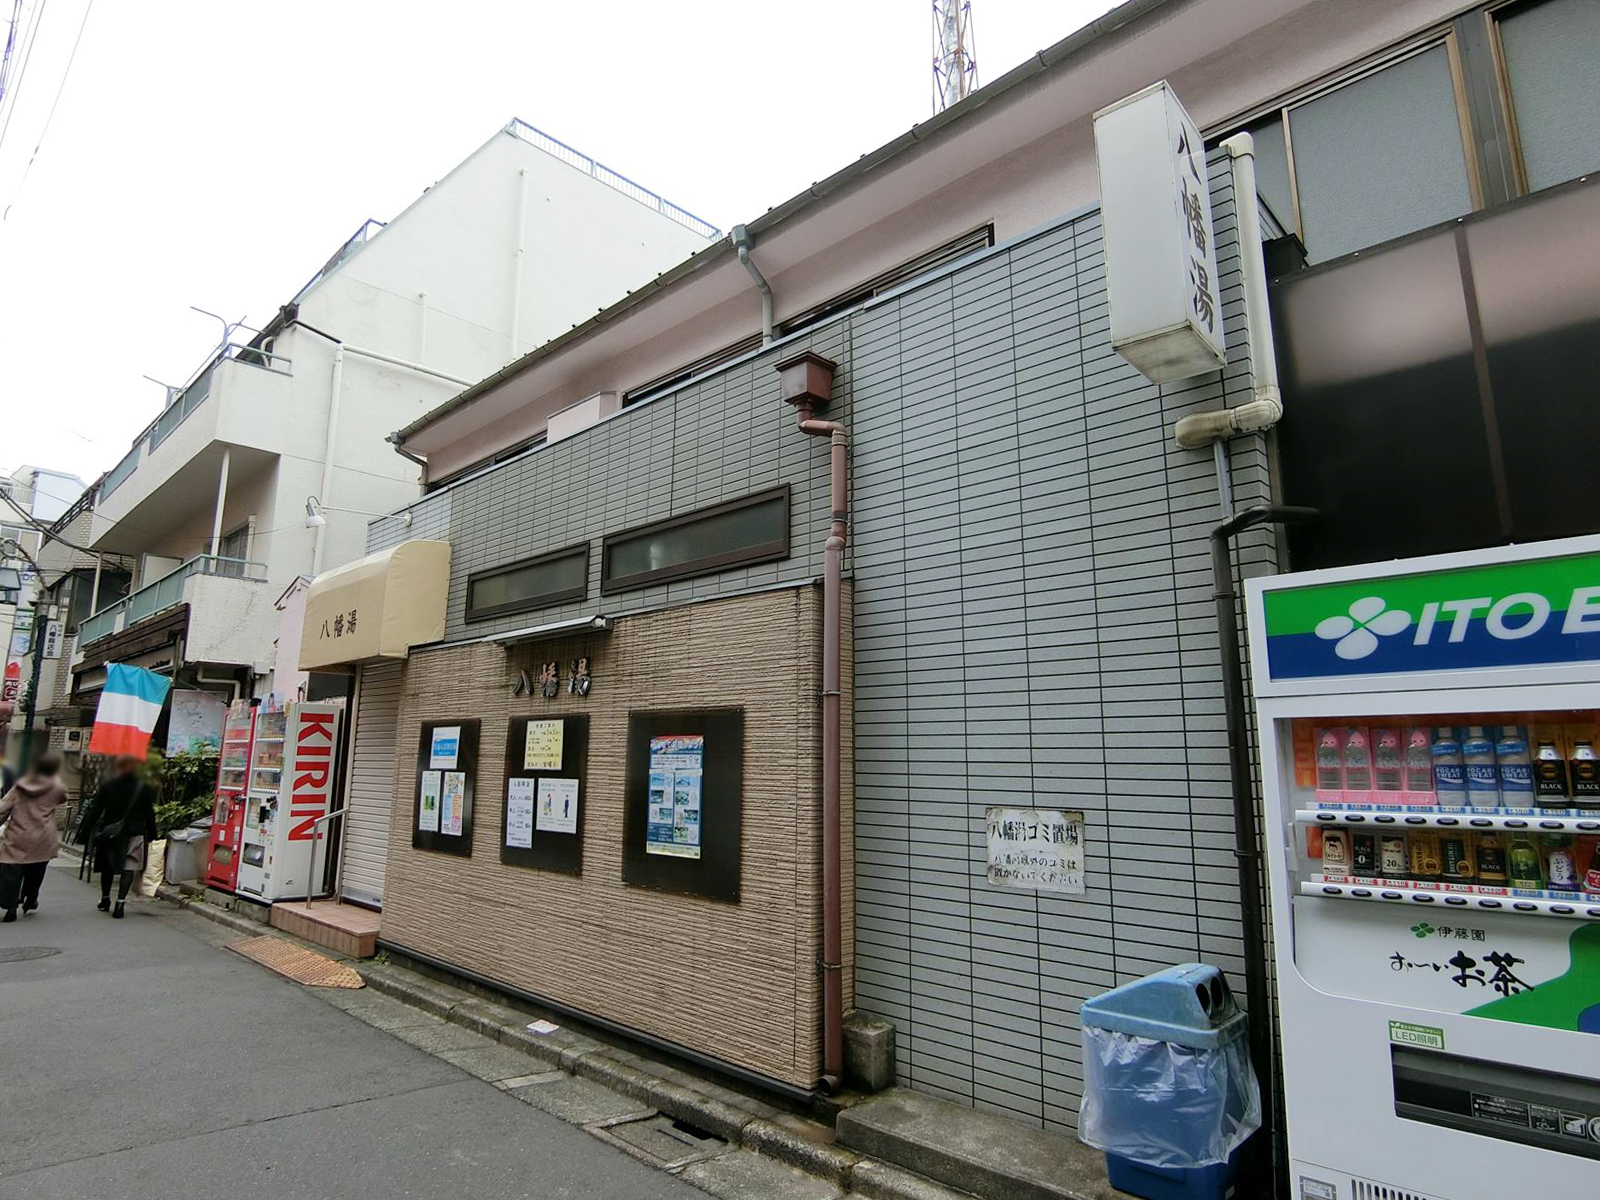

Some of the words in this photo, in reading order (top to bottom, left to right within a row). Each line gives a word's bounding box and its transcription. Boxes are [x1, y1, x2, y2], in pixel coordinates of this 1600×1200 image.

[1177, 121, 1214, 334] 八幡湯
[319, 609, 358, 641] 八幡湯
[1413, 592, 1551, 646] ITO
[513, 657, 591, 698] 八幡湯
[288, 712, 336, 842] KIRIN
[1386, 859, 1397, 868] 20
[1437, 925, 1486, 942] 伊藤園
[1395, 1031, 1438, 1046] LED照明
